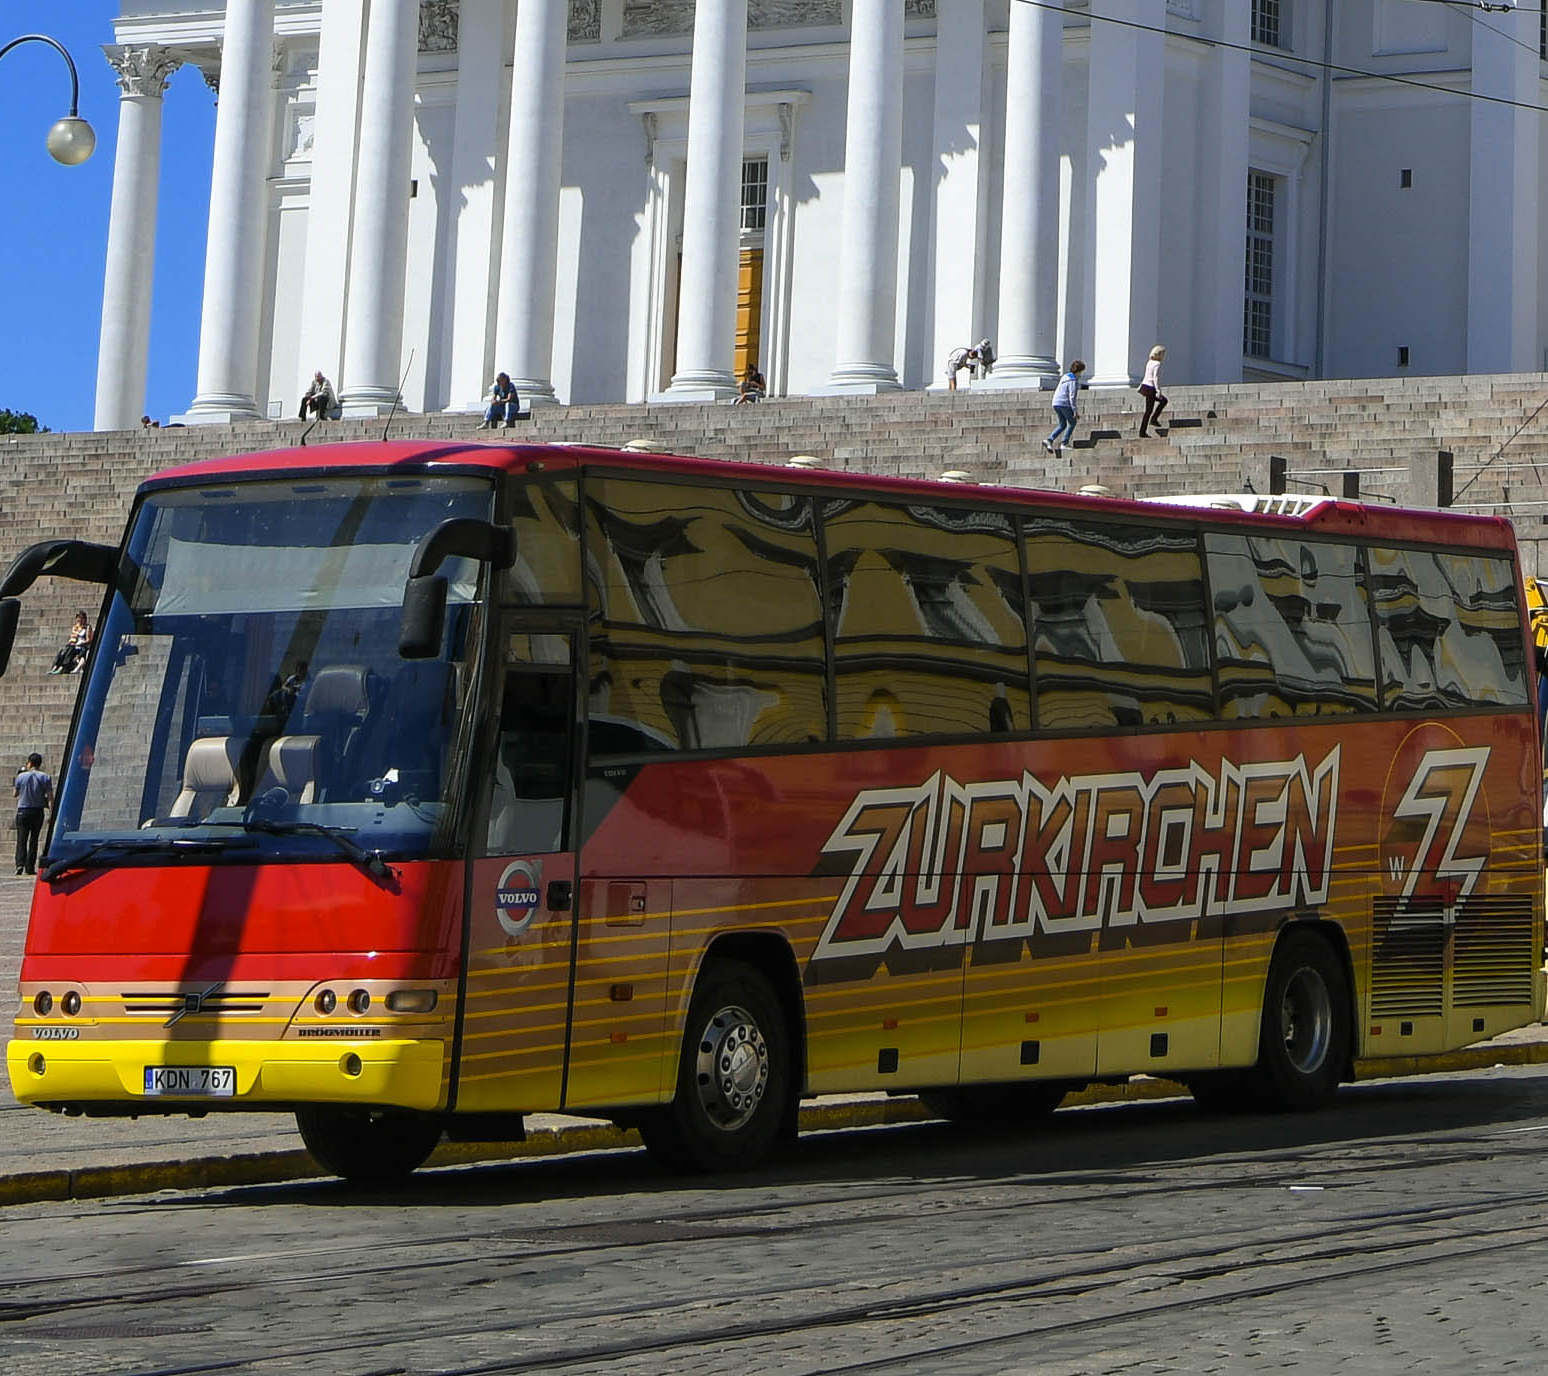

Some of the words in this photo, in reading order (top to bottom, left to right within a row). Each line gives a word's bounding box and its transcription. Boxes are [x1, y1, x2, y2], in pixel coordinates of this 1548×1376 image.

[811, 744, 1341, 960] ZURKIRCHEN
[498, 893, 537, 904] VOLVO
[31, 1027, 80, 1040] VOLVO
[154, 1069, 190, 1089] KDN
[201, 1069, 231, 1089] 767
